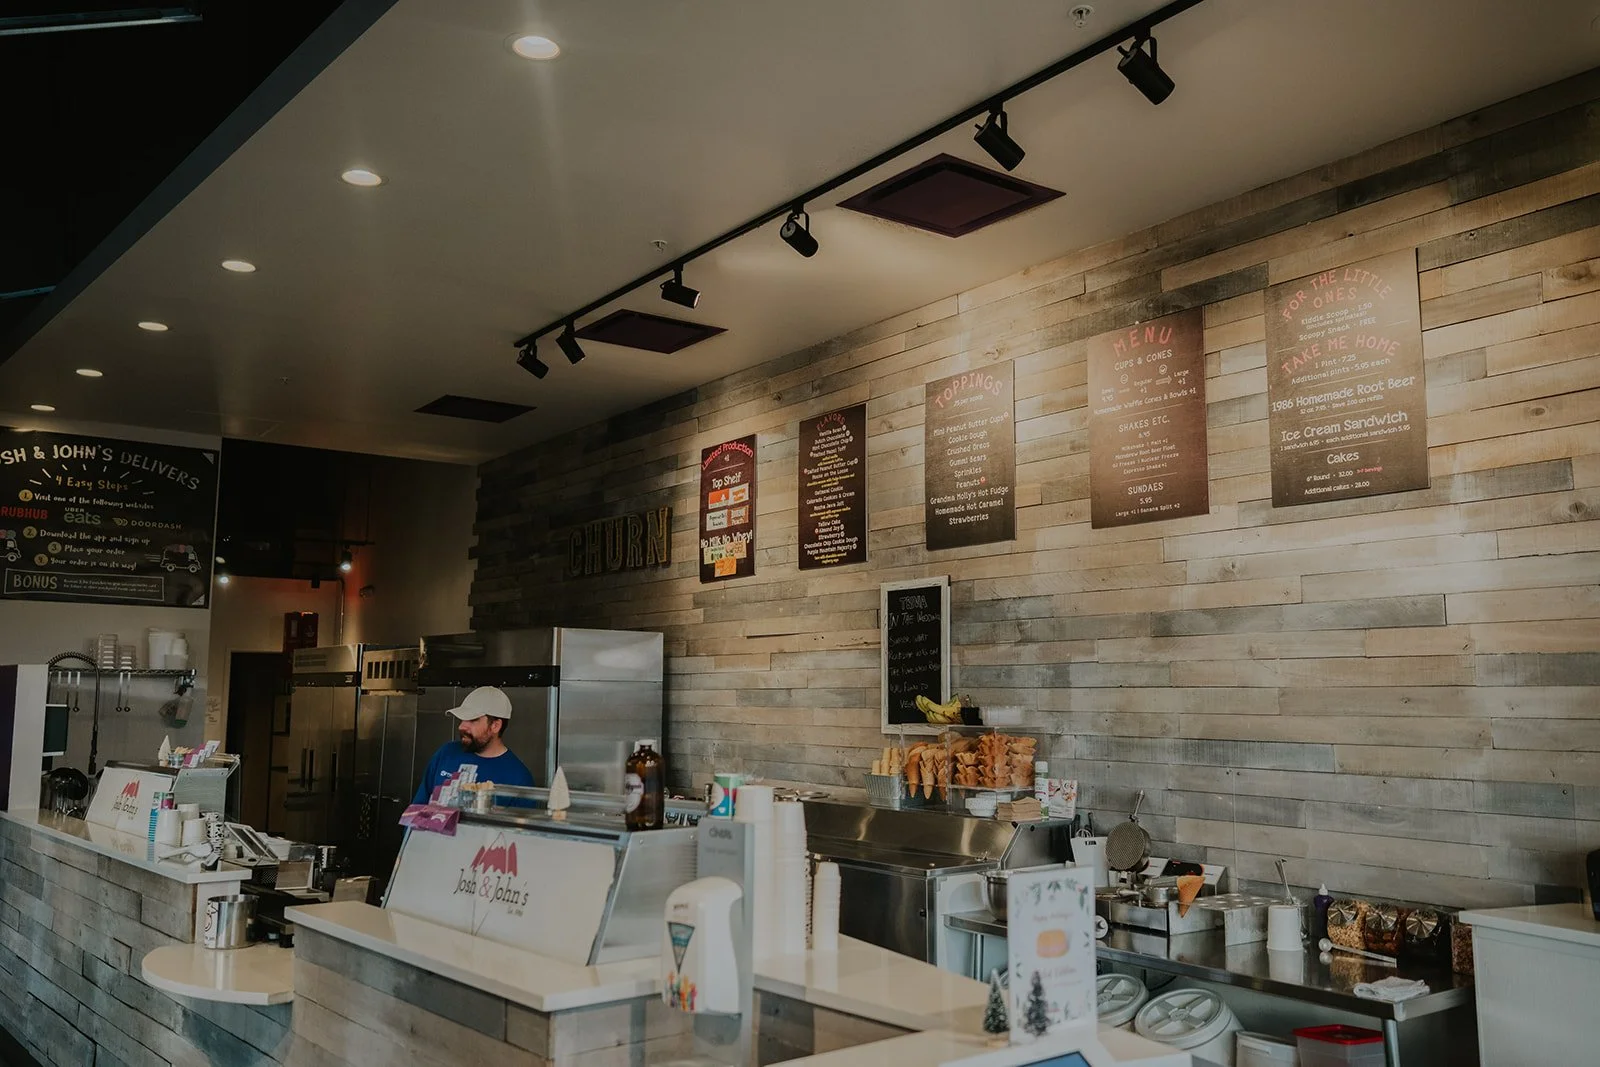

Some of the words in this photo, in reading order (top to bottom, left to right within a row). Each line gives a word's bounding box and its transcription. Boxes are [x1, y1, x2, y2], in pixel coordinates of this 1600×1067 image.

[1283, 290, 1307, 322] FOR
[1310, 270, 1337, 290] THE
[1344, 268, 1393, 300] LITTLE
[1313, 287, 1357, 308] ONES
[1301, 315, 1324, 325] Kiddie
[1326, 309, 1349, 319] Scoop
[1299, 330, 1326, 341] Scoopy
[1328, 324, 1350, 334] Snack
[1359, 316, 1377, 326] FREE
[1113, 327, 1173, 358] MENU
[1114, 359, 1134, 371] CUPS
[1137, 357, 1143, 365] &
[1146, 349, 1173, 362] CONES
[1281, 343, 1322, 374] TAKE
[1328, 335, 1348, 351] ME
[1356, 334, 1401, 356] HOME
[1321, 358, 1337, 368] Pint
[1291, 371, 1330, 385] Additional
[1330, 366, 1350, 376] pints
[1370, 358, 1390, 367] each
[935, 373, 1004, 409] TOPPINGS
[1271, 399, 1294, 412] 1986
[1296, 387, 1354, 407] Homemade
[1357, 380, 1385, 395] Root
[1387, 375, 1416, 390] Beer
[1331, 401, 1346, 409] Save
[1118, 419, 1150, 433] SHAKES
[1152, 414, 1170, 426] ETC.
[1281, 429, 1301, 442] Ice
[1304, 422, 1341, 438] Cream
[1343, 410, 1408, 431] Sandwich
[948, 434, 969, 444] Cookie
[969, 430, 988, 440] Dough
[1283, 441, 1309, 451] sandwich
[1325, 436, 1340, 444] each
[1340, 431, 1369, 441] additional
[1369, 427, 1398, 437] sandwich
[702, 445, 722, 471] Limited
[723, 441, 754, 459] Production
[1326, 451, 1360, 465] Cakes
[0, 447, 27, 465] SH
[33, 446, 46, 460] &
[53, 444, 113, 462] JOHN'S
[120, 451, 201, 490] DELIVERS
[954, 466, 983, 478] Sprinkles
[56, 475, 63, 486] 4
[67, 476, 94, 491] Easy
[98, 479, 129, 493] Steps
[712, 478, 724, 490] Top
[724, 471, 743, 486] Shelf
[1313, 473, 1331, 481] Round
[929, 494, 956, 505] Grandma
[978, 488, 989, 497] Hot
[989, 486, 1009, 496] Fudge
[1127, 482, 1164, 495] SUNDAES
[1303, 484, 1333, 496] Additional
[1332, 483, 1351, 491] cakes
[34, 493, 52, 502] Visit
[69, 496, 77, 504] of
[935, 504, 965, 516] Homemade
[966, 502, 977, 511] Hot
[978, 498, 1004, 509] Caramel
[64, 512, 102, 526] eats
[131, 519, 184, 530] DOORDASH
[948, 513, 989, 526] Strawberries
[40, 529, 78, 540] Download
[568, 505, 672, 578] CHURN
[64, 544, 85, 553] Place
[86, 547, 103, 556] your
[105, 547, 126, 556] order
[13, 573, 58, 590] BONUS
[453, 868, 477, 895] Josh
[478, 876, 492, 899] &
[489, 876, 529, 906] John's
